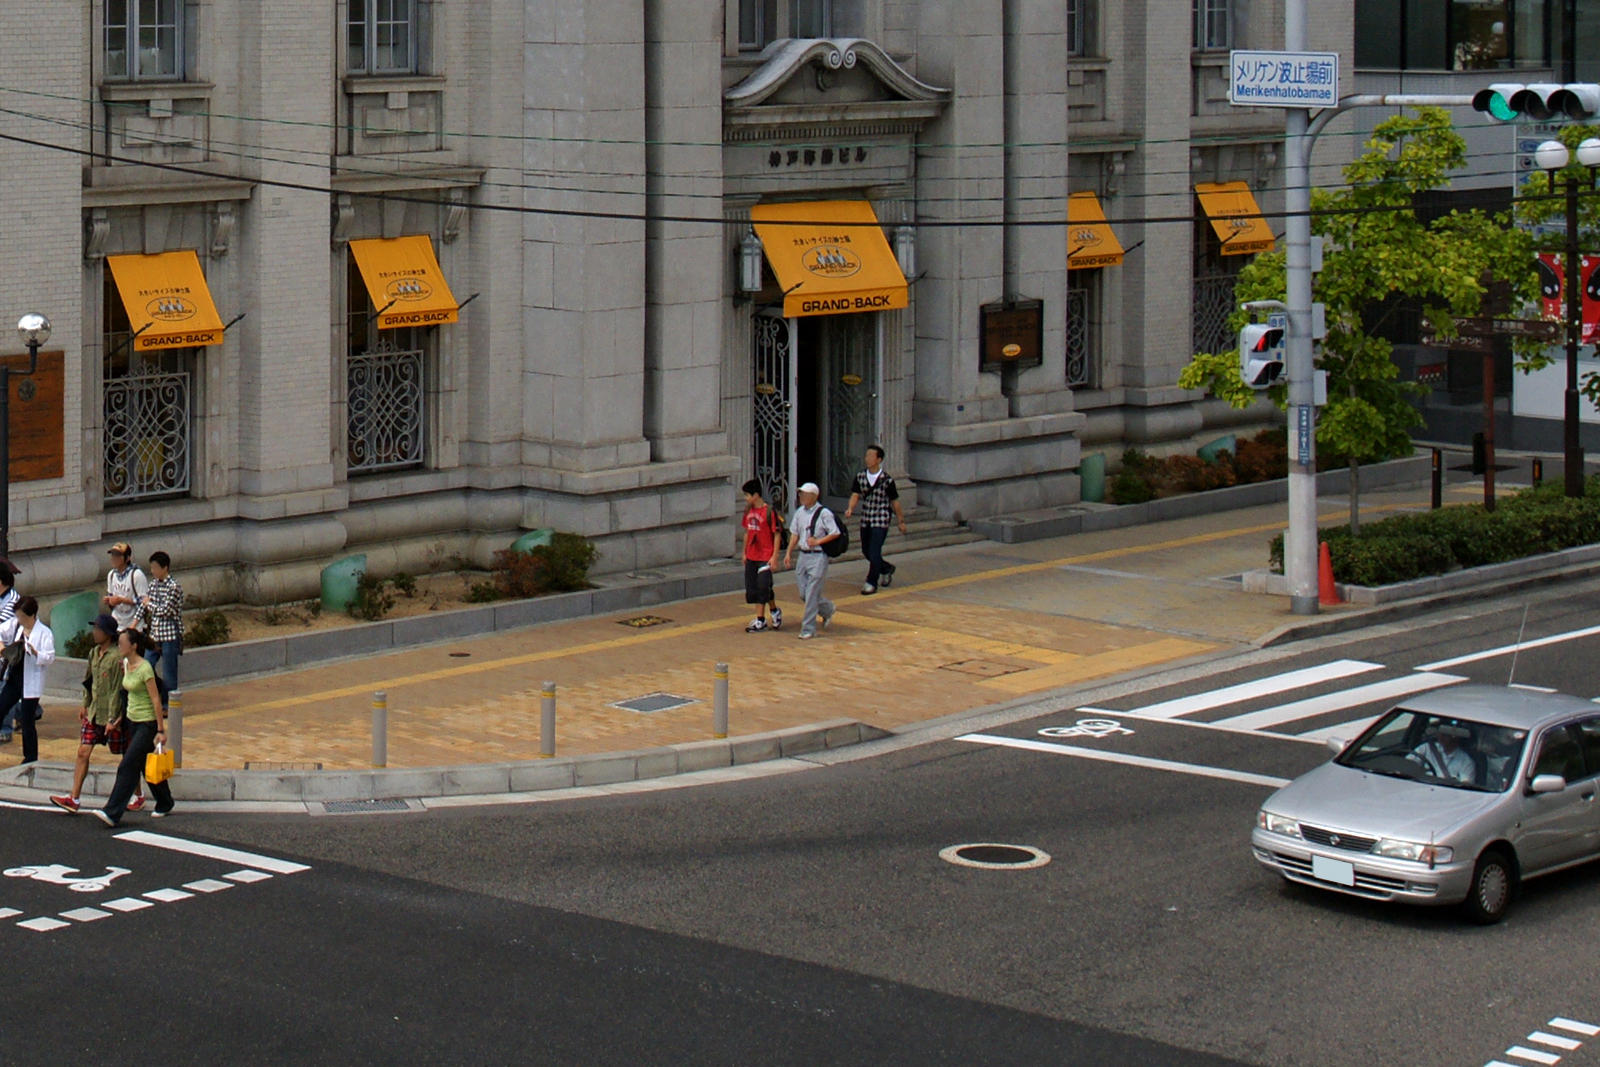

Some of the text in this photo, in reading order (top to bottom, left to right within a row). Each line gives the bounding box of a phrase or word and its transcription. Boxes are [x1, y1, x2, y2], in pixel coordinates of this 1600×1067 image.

[1236, 60, 1333, 85] メリケン波止場前
[1237, 84, 1331, 99] Merikenhatobamae
[802, 295, 890, 313] GRAND-BACK
[384, 312, 450, 325] GRAND-BACK
[142, 333, 215, 347] GRAND-BACK
